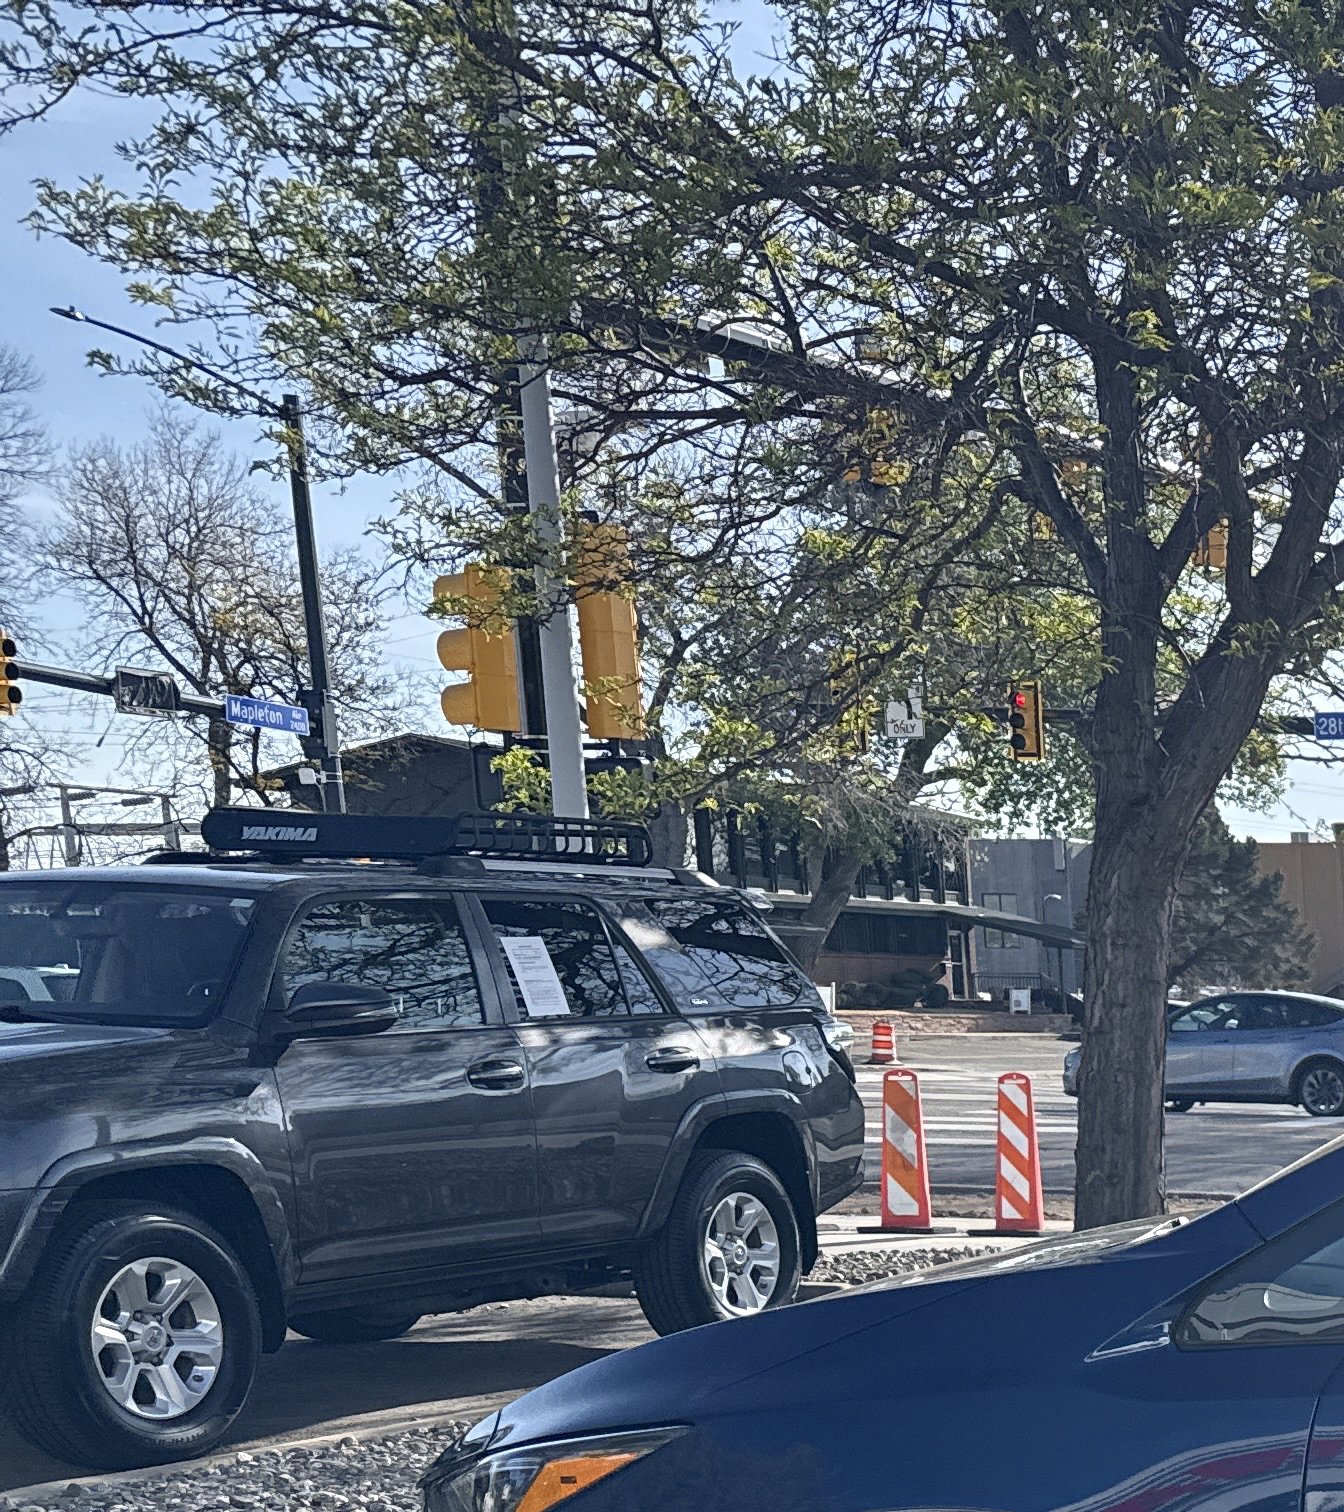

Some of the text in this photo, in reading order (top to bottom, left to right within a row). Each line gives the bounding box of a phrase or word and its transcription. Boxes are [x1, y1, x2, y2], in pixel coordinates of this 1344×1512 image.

[231, 699, 283, 725] Mapleton
[893, 723, 916, 734] ONLY
[240, 826, 319, 841] YAKIMA
